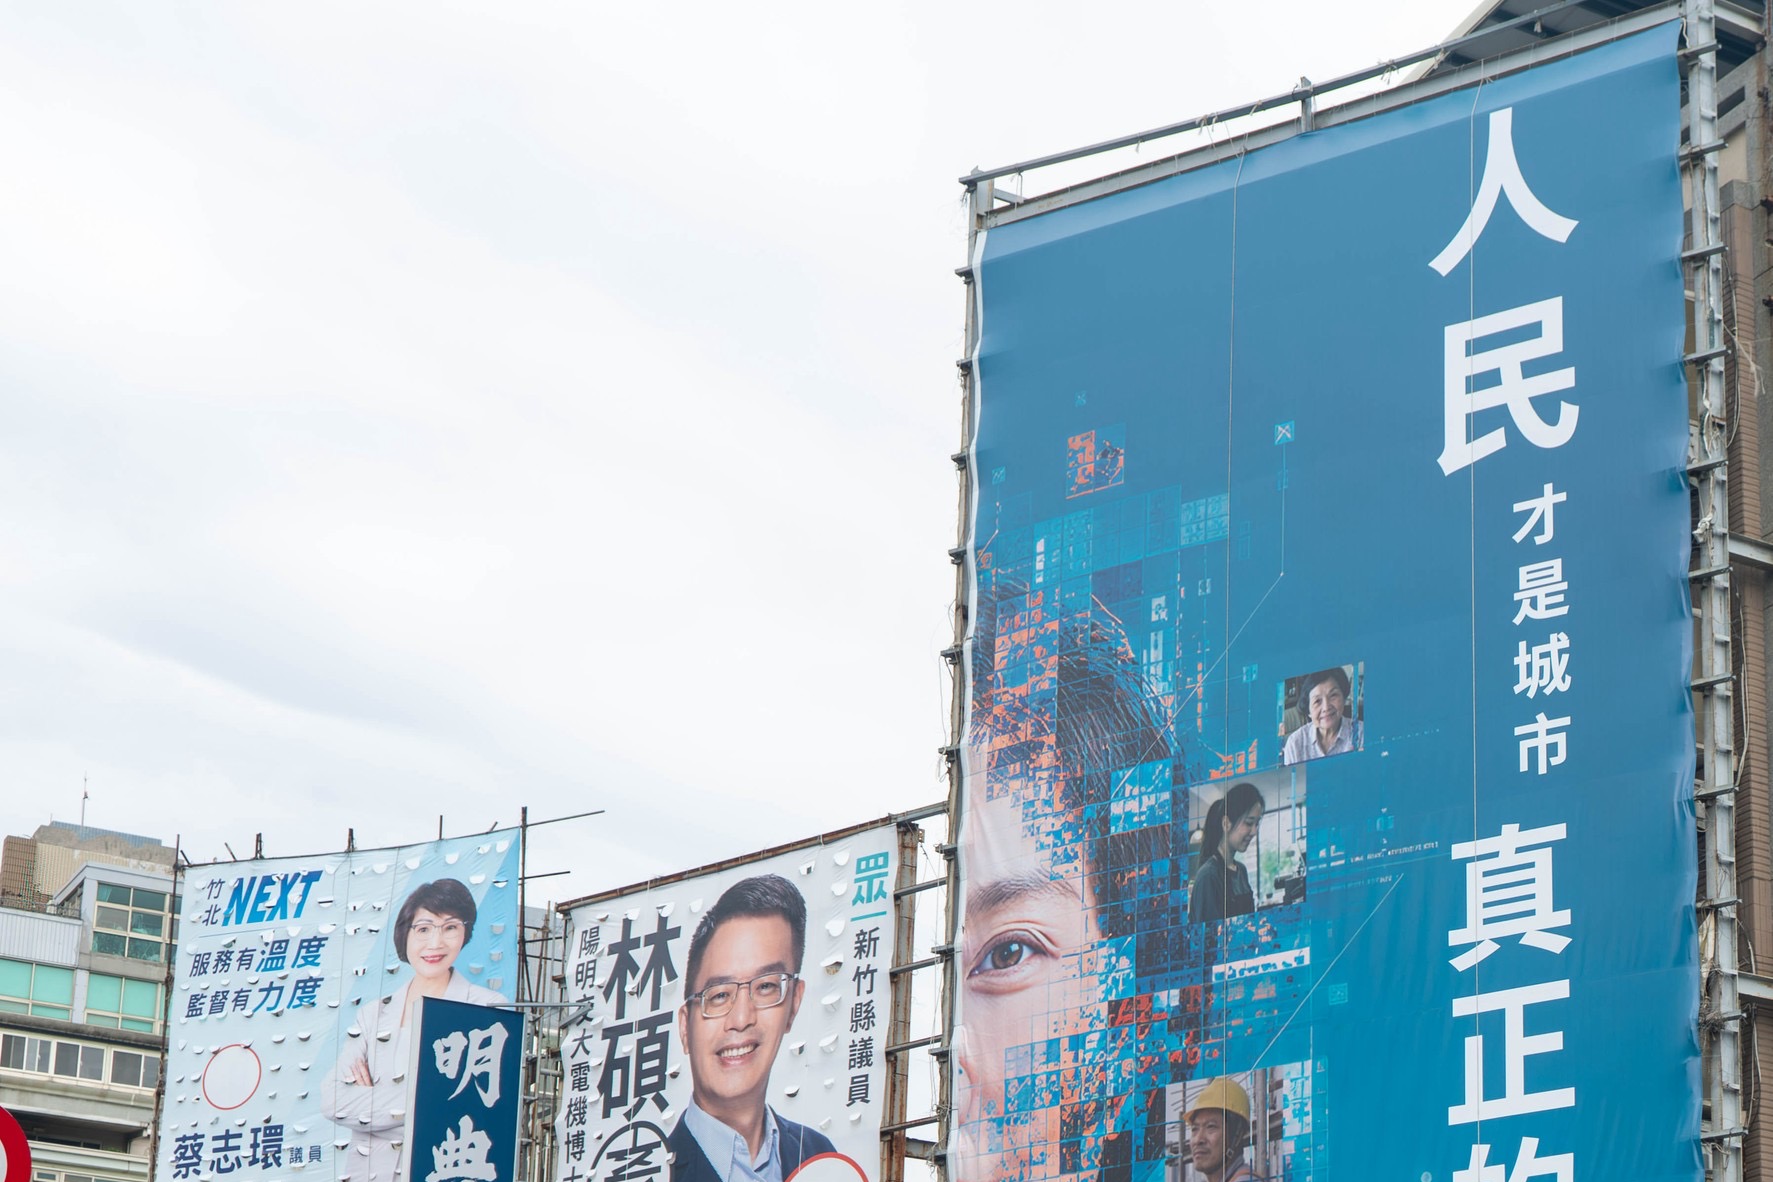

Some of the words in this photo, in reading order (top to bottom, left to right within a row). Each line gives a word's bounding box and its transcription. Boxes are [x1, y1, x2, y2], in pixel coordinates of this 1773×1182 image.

[202, 878, 226, 927] 竹北
[221, 869, 324, 927] NEXT
[188, 935, 329, 978] 服務有溫度
[184, 975, 325, 1020] 監督有力度
[846, 926, 881, 1108] 新竹縣議員
[172, 1124, 284, 1180] 蔡志環
[288, 1145, 322, 1165] 議員
